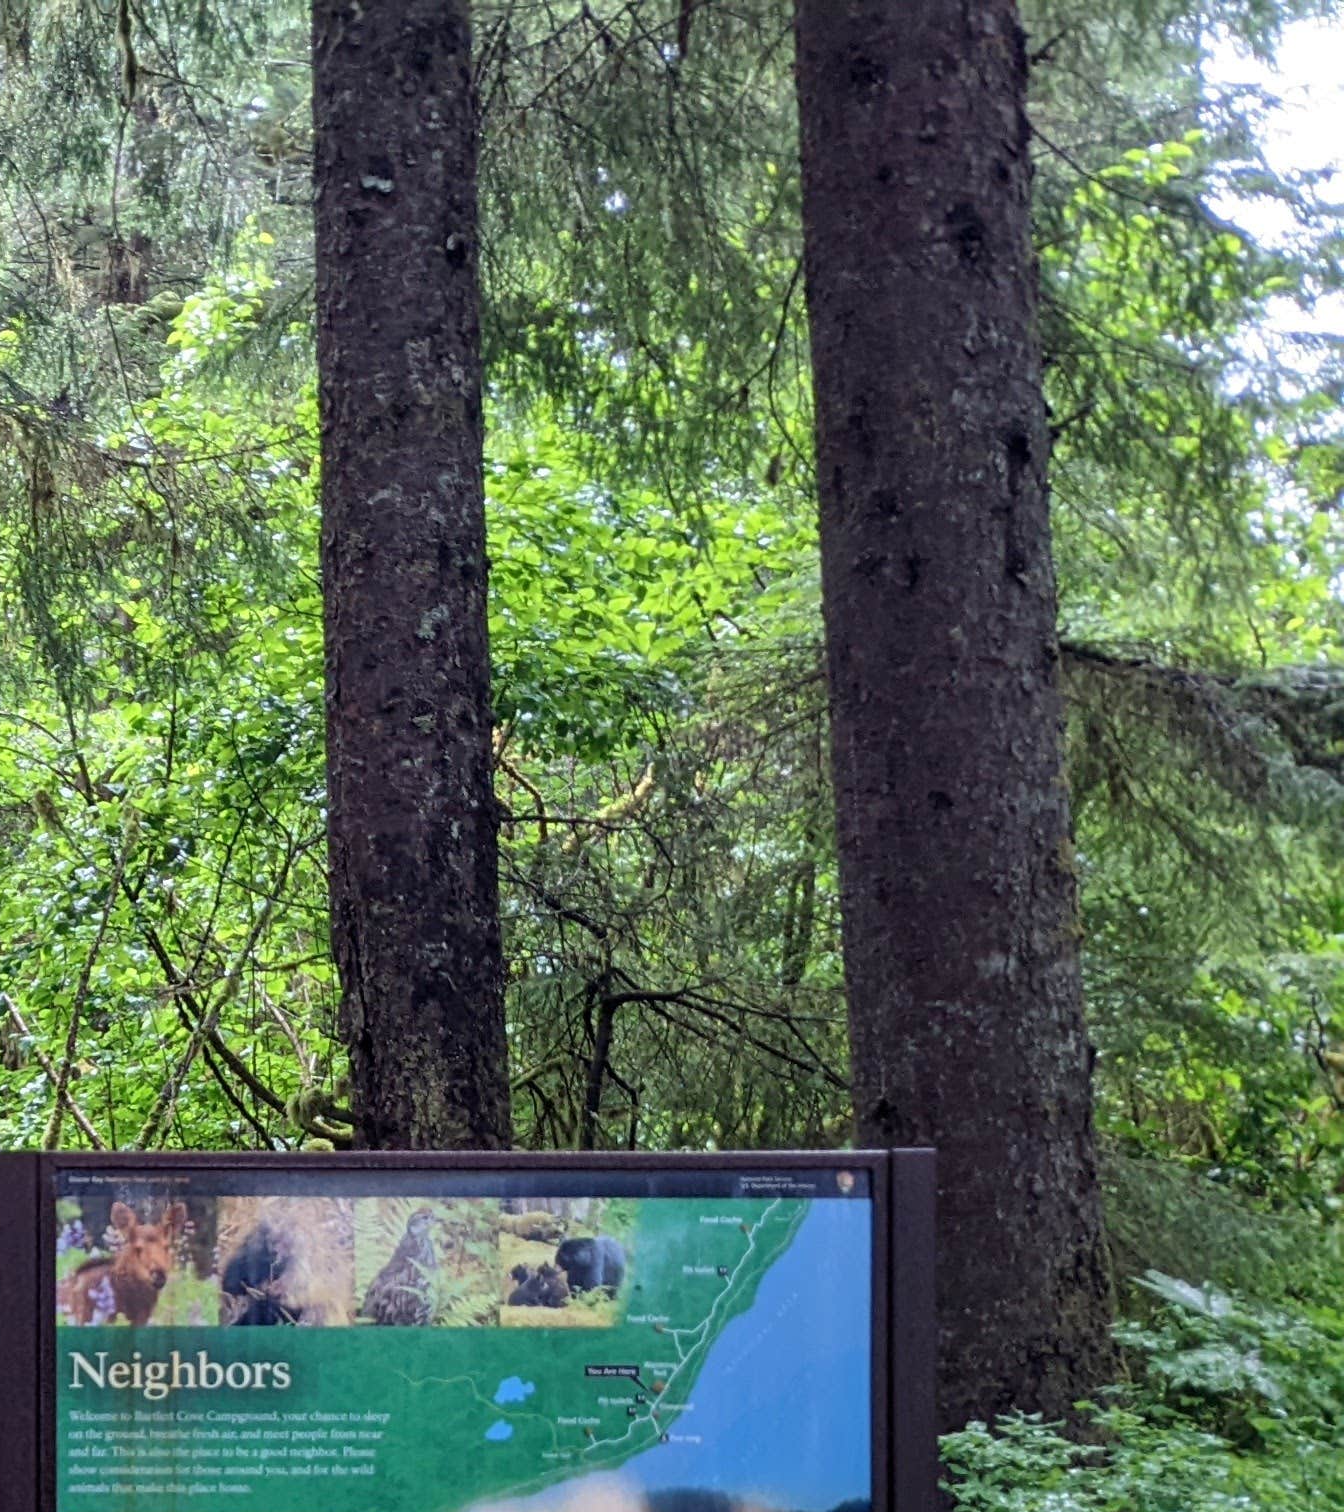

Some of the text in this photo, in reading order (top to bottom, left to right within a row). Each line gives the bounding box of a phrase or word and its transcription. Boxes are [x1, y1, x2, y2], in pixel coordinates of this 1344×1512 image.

[68, 1350, 292, 1400] Neighbors
[68, 1410, 119, 1422] Welcome
[120, 1412, 133, 1422] to
[176, 1410, 205, 1422] Cove
[282, 1413, 309, 1425] your
[309, 1410, 348, 1422] chance
[349, 1412, 361, 1422] to
[363, 1410, 391, 1425] sleep
[68, 1431, 84, 1441] on
[85, 1429, 104, 1441] the
[239, 1429, 262, 1441] and
[291, 1429, 329, 1443] people
[330, 1429, 357, 1441] from
[68, 1446, 90, 1458] and
[221, 1448, 235, 1458] to
[235, 1446, 249, 1458] be
[260, 1446, 288, 1461] good
[290, 1464, 311, 1475] and
[331, 1464, 348, 1475] the
[351, 1464, 376, 1475] wild
